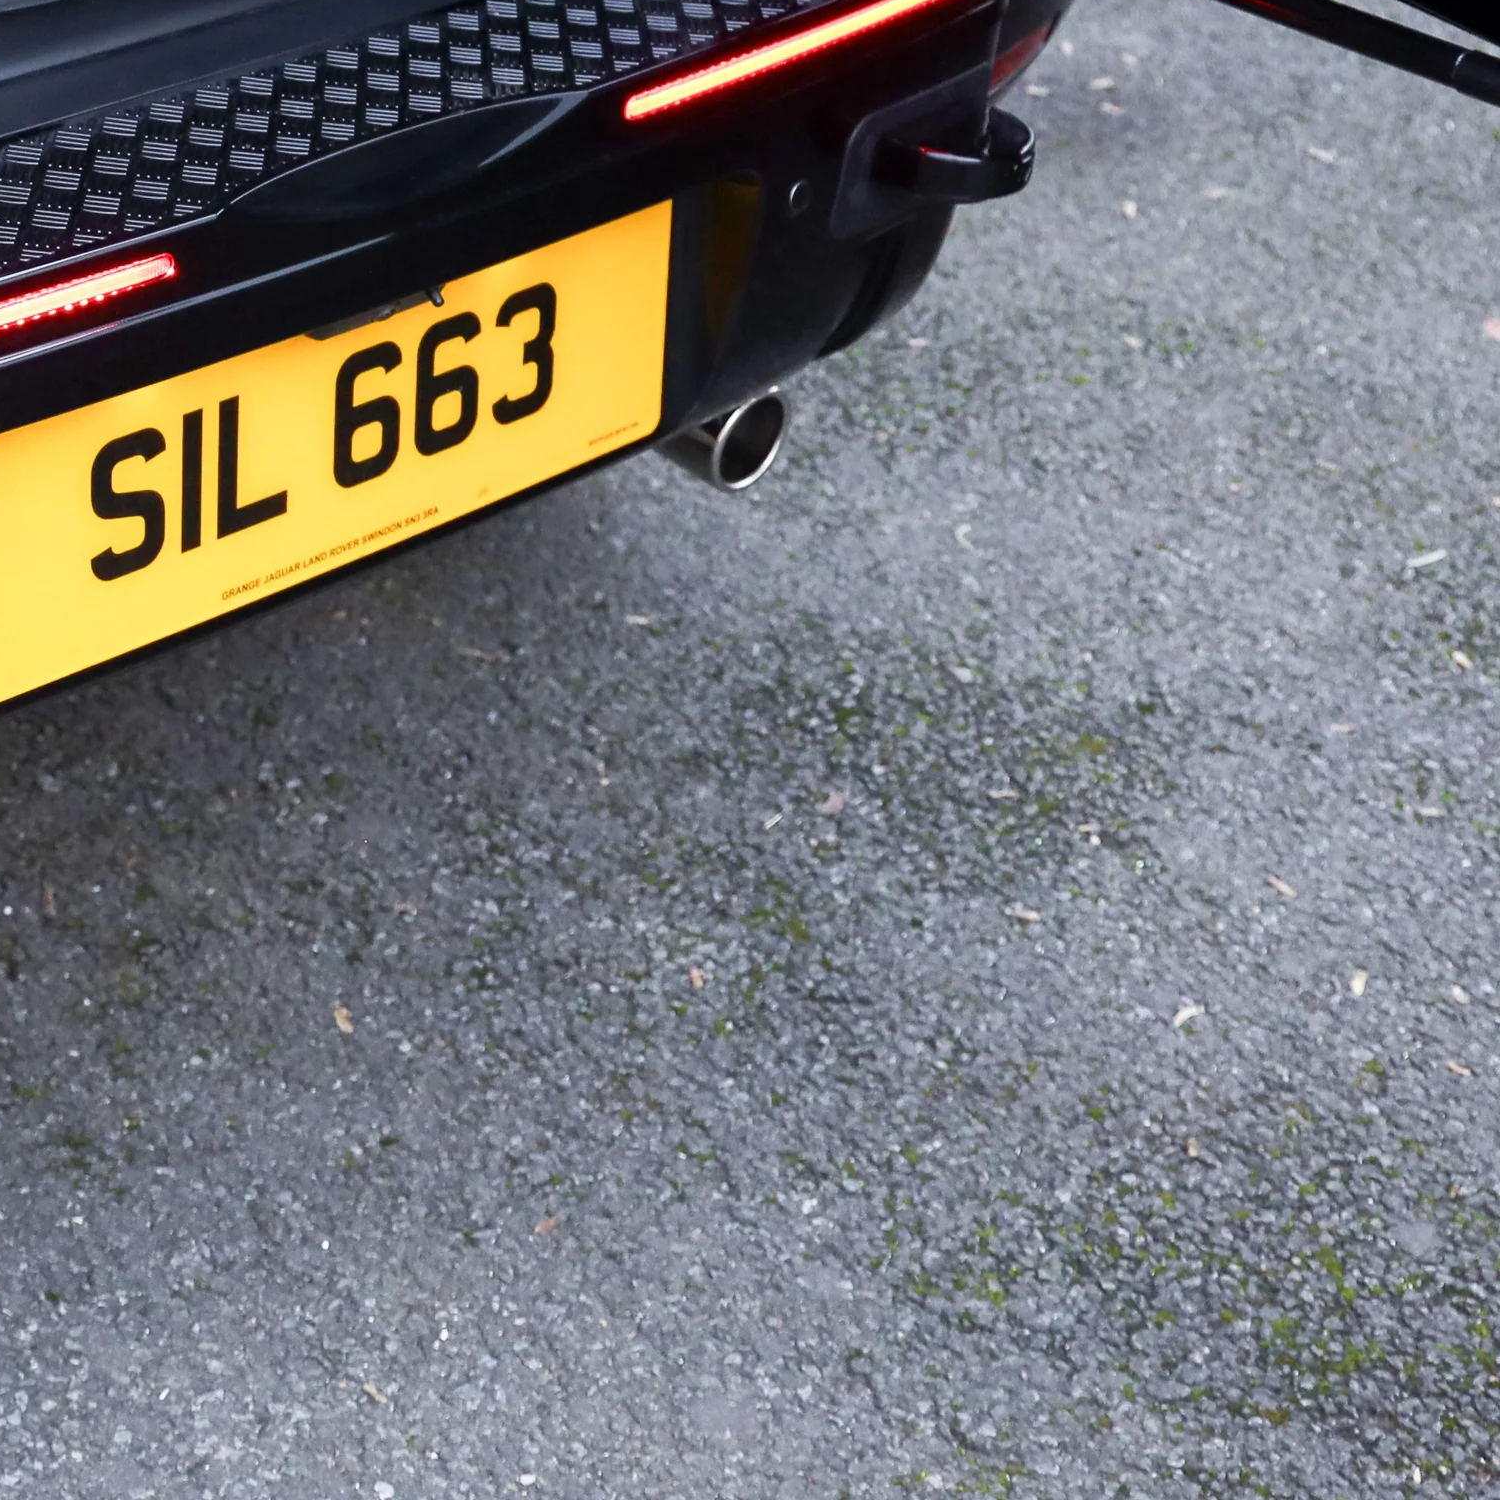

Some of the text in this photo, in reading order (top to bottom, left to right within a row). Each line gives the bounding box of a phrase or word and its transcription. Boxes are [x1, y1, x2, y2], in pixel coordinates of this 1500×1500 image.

[90, 282, 558, 582] SIL 663
[221, 576, 262, 601] GRANGE
[263, 562, 301, 584] JAGUAR
[303, 552, 328, 569] LAND
[329, 538, 359, 558] ROVER
[361, 521, 403, 545] SWINDON
